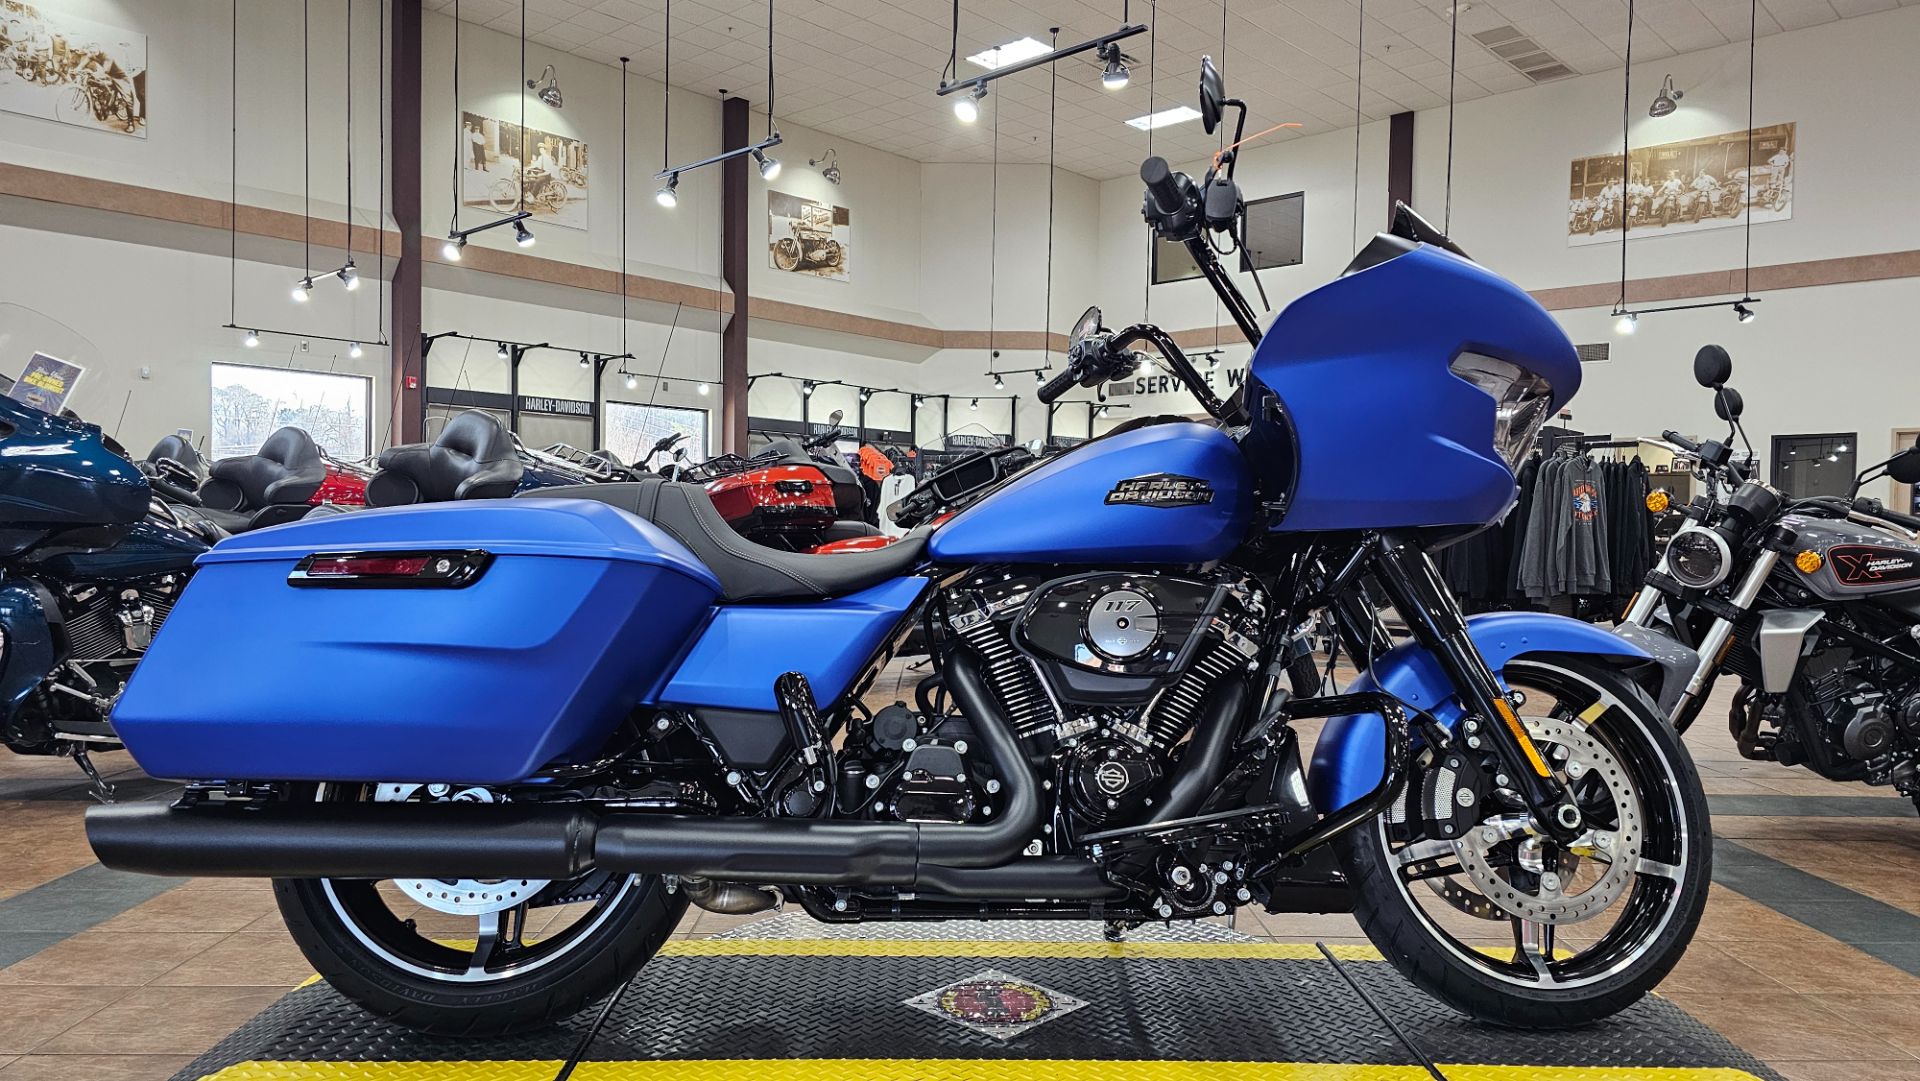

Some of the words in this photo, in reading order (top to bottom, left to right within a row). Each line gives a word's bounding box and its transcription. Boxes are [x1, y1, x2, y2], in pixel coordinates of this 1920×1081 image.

[1136, 371, 1214, 394] SERVE
[525, 397, 591, 415] HARLEY-DAVIDSON
[1104, 600, 1142, 612] 117
